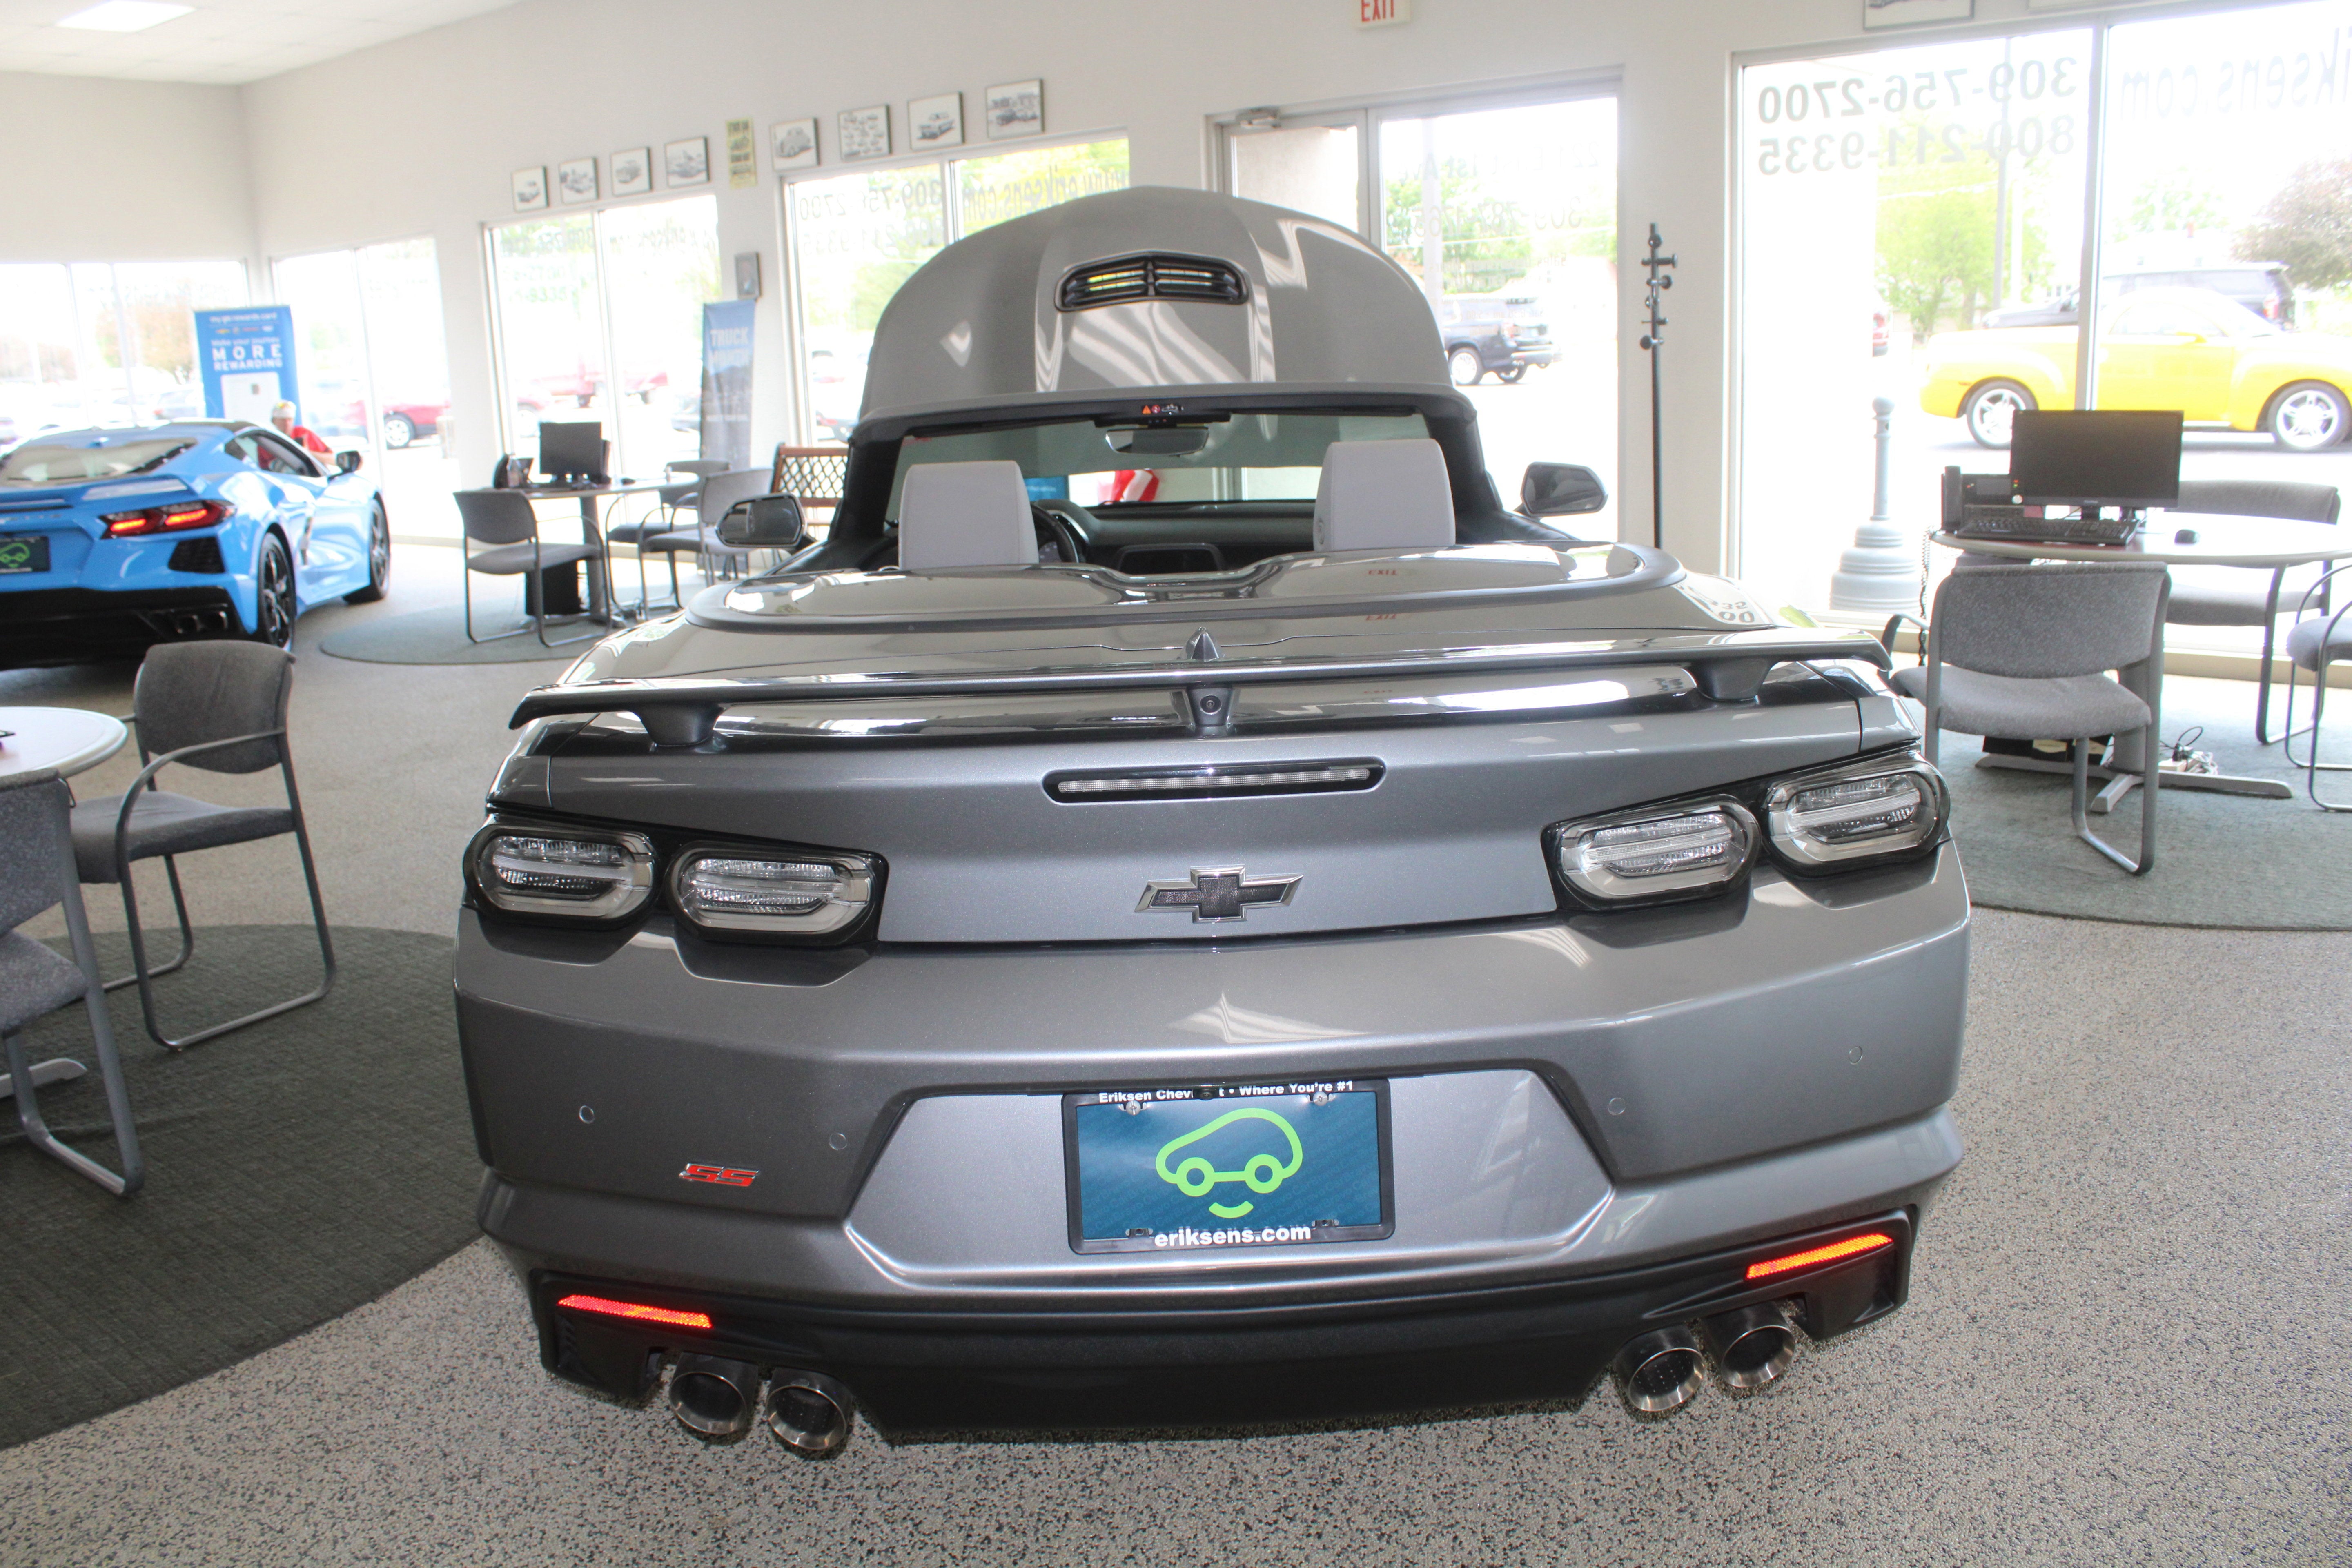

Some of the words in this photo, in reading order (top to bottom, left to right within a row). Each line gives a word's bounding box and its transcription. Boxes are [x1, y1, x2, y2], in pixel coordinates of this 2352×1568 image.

[710, 327, 749, 346] TRUCK
[212, 343, 282, 362] MORE
[214, 358, 283, 372] REWARDING
[1098, 1091, 1152, 1103] Eriksen
[1239, 1085, 1285, 1096] Where
[1289, 1082, 1334, 1094] You're
[1337, 1080, 1353, 1091] #1
[679, 1163, 760, 1187] SS
[1154, 1226, 1312, 1247] eriksens.com
